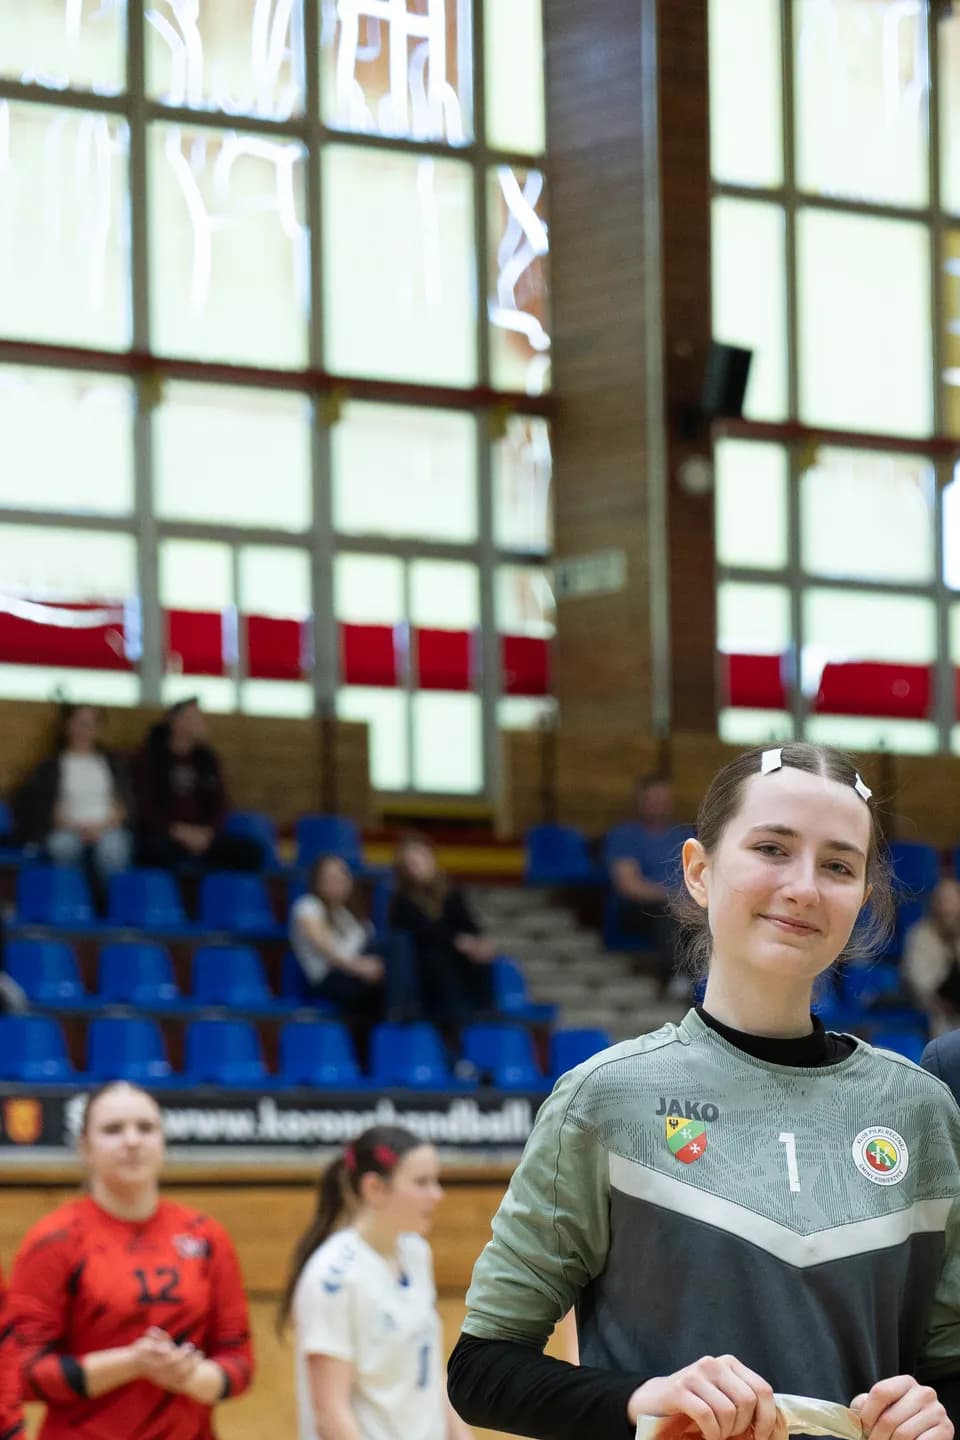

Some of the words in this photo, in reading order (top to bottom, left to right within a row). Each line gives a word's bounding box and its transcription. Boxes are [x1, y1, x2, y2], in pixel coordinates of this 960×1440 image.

[655, 1097, 720, 1123] JAKO
[778, 1132, 801, 1192] 1
[133, 1267, 181, 1304] 12
